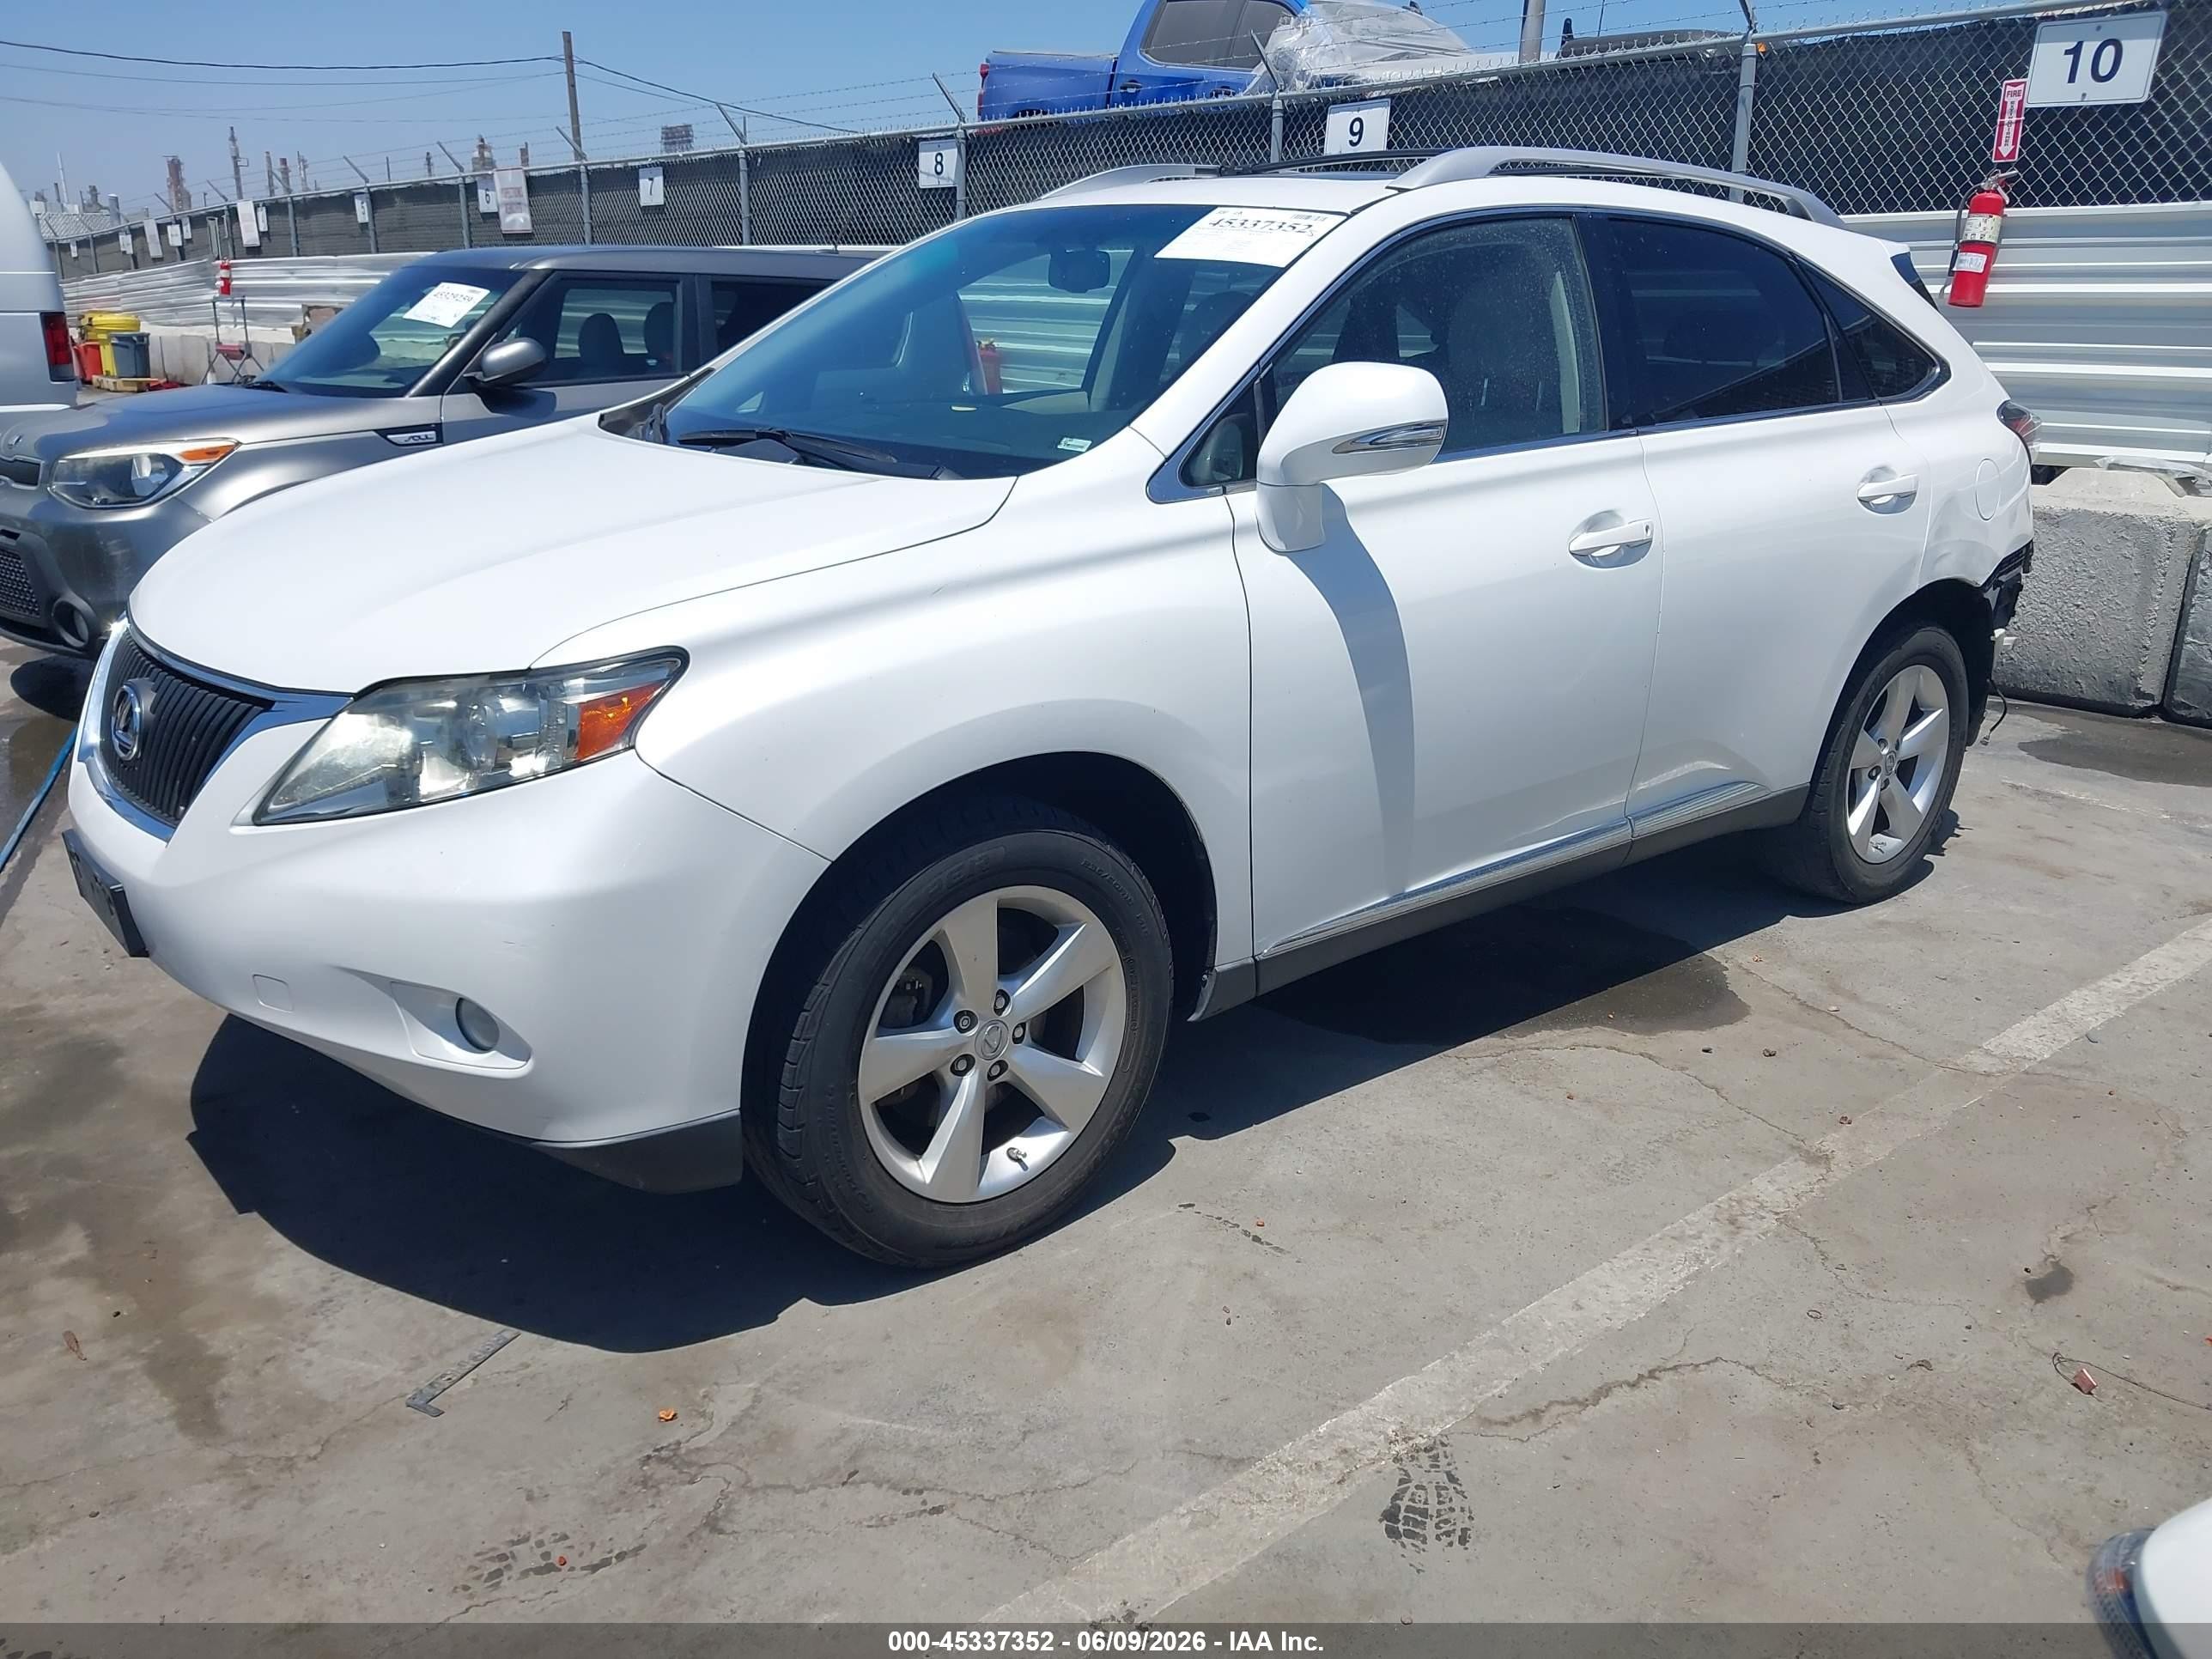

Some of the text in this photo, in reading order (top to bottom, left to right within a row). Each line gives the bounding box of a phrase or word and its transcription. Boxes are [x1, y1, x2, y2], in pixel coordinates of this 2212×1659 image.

[2063, 38, 2124, 84] 10
[2006, 89, 2023, 98] FIRE
[1348, 117, 1364, 147] 9
[934, 152, 944, 175] 8
[484, 188, 490, 204] 6
[648, 177, 653, 196] 7
[1209, 217, 1313, 234] 45337352
